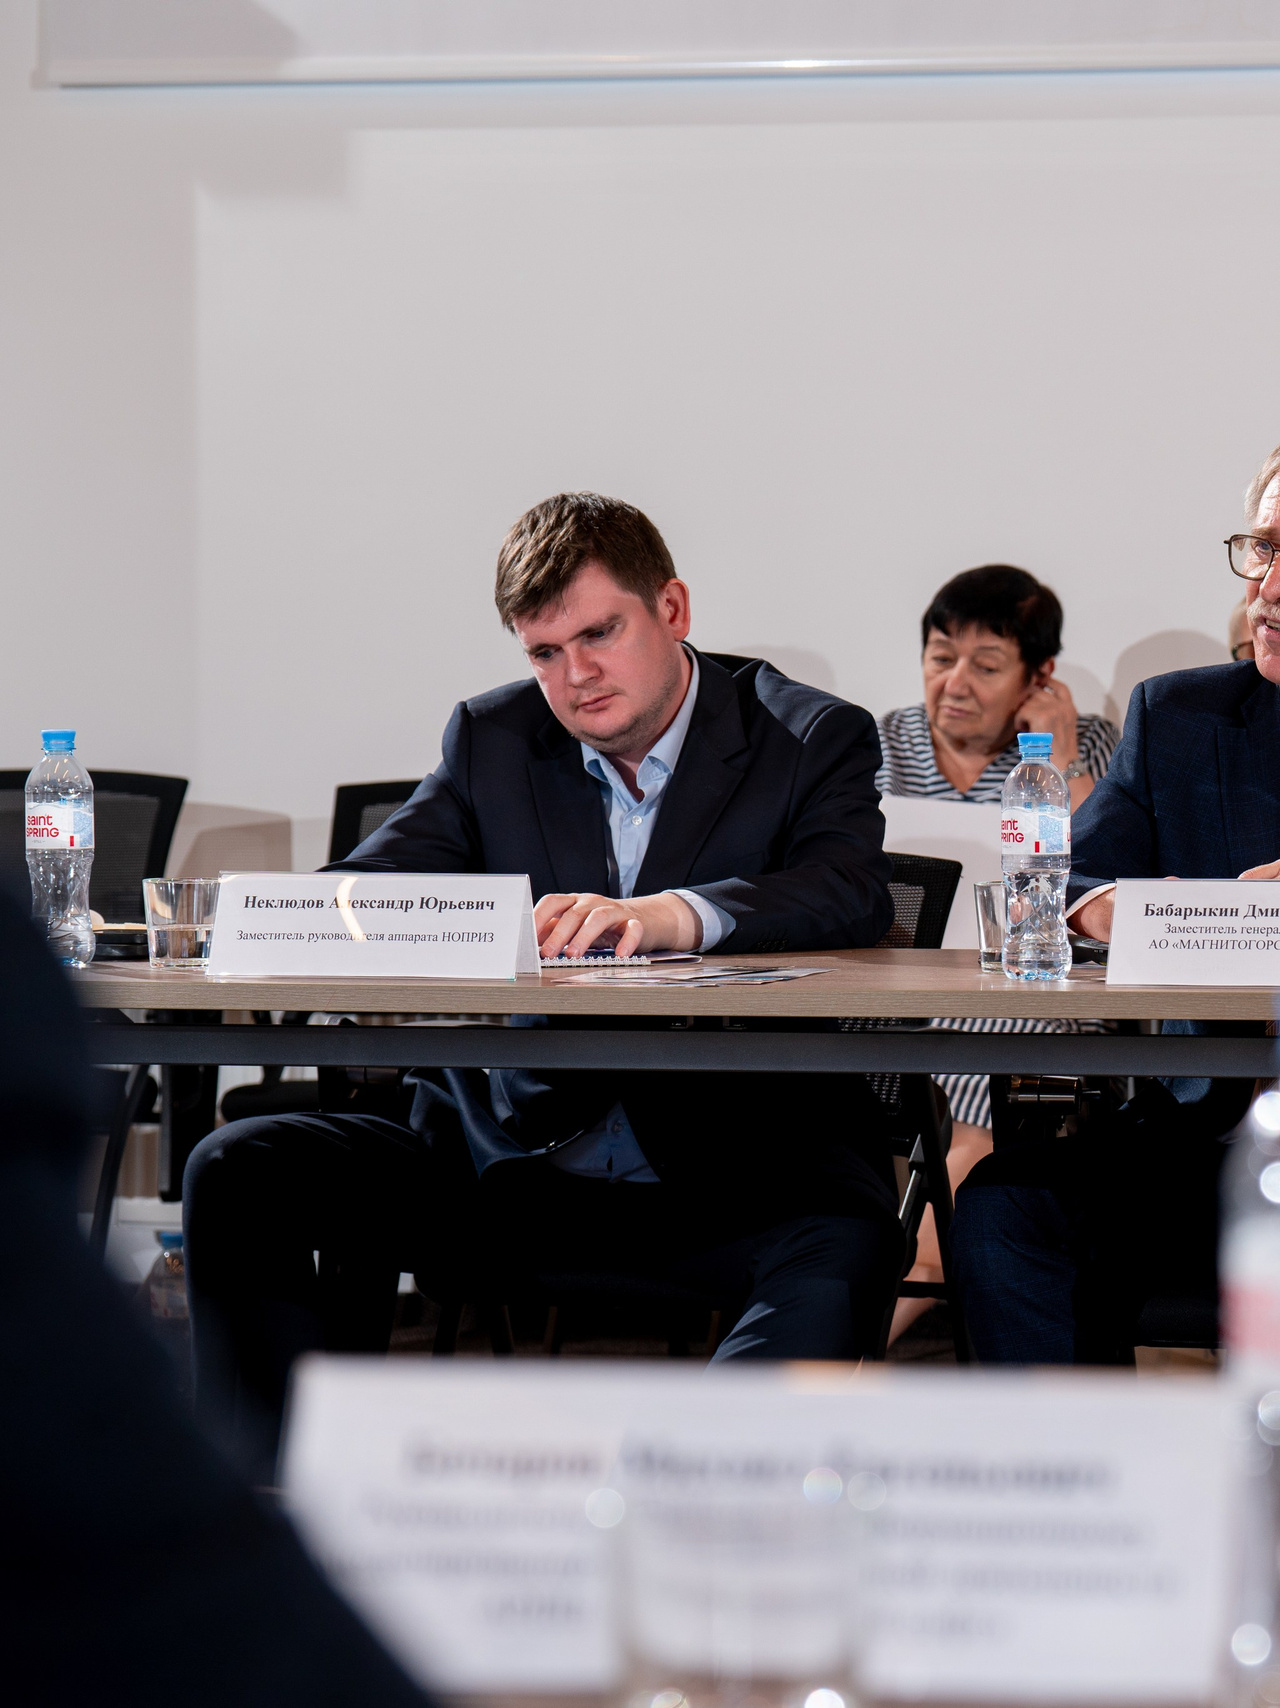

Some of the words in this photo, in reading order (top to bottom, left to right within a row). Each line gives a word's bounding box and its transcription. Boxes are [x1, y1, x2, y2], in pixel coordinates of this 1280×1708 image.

[243, 895, 325, 910] Неклюдов
[328, 896, 415, 913] Аександр
[418, 896, 495, 914] Юрьевич
[1143, 903, 1240, 920] Бабарыкин
[1164, 922, 1238, 935] Заместитель
[236, 929, 305, 941] Заместитель
[387, 933, 439, 945] аппарата
[441, 931, 495, 943] НОПРИЗ
[1148, 938, 1169, 950] АО
